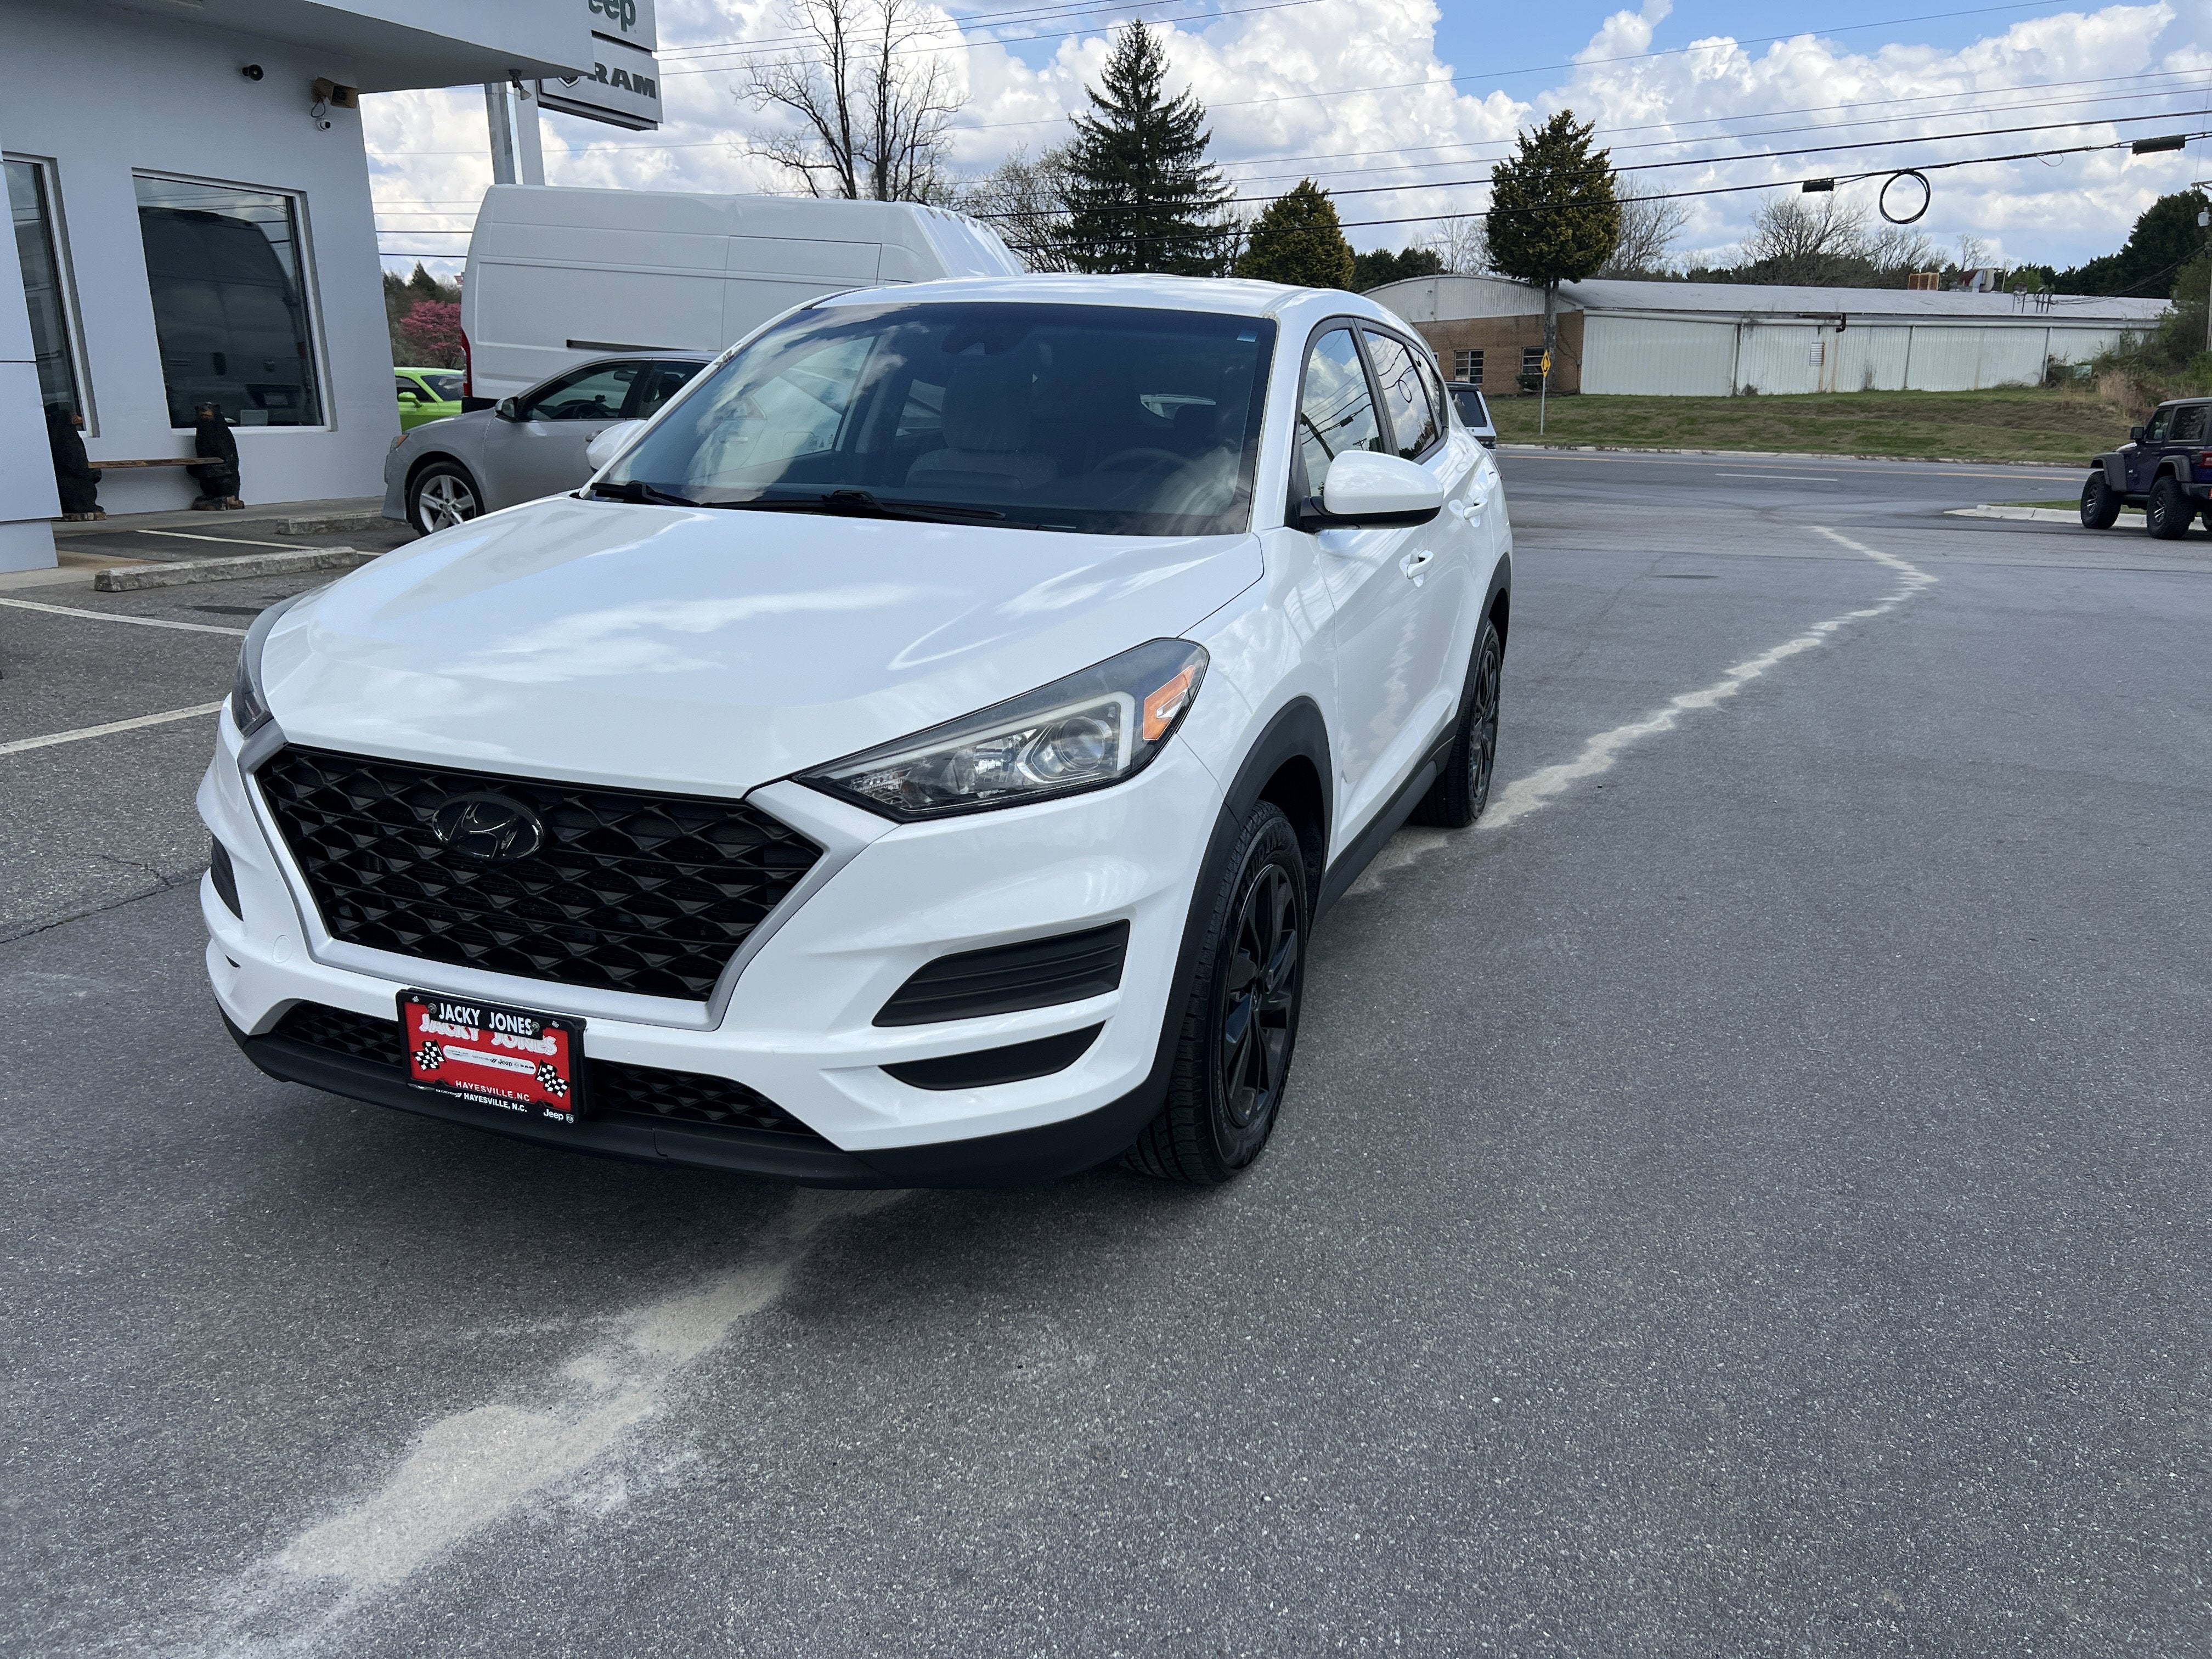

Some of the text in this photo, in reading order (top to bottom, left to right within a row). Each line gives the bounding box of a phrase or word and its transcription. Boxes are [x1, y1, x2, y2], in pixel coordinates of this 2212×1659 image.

[588, 62, 656, 99] RAM
[439, 1003, 532, 1036] JACKY JONES
[419, 1013, 557, 1056] JACKY JONES
[498, 1058, 512, 1067] Jeep
[464, 1092, 527, 1113] HAYESVILLE, N.C.
[543, 1109, 564, 1121] Jeep
